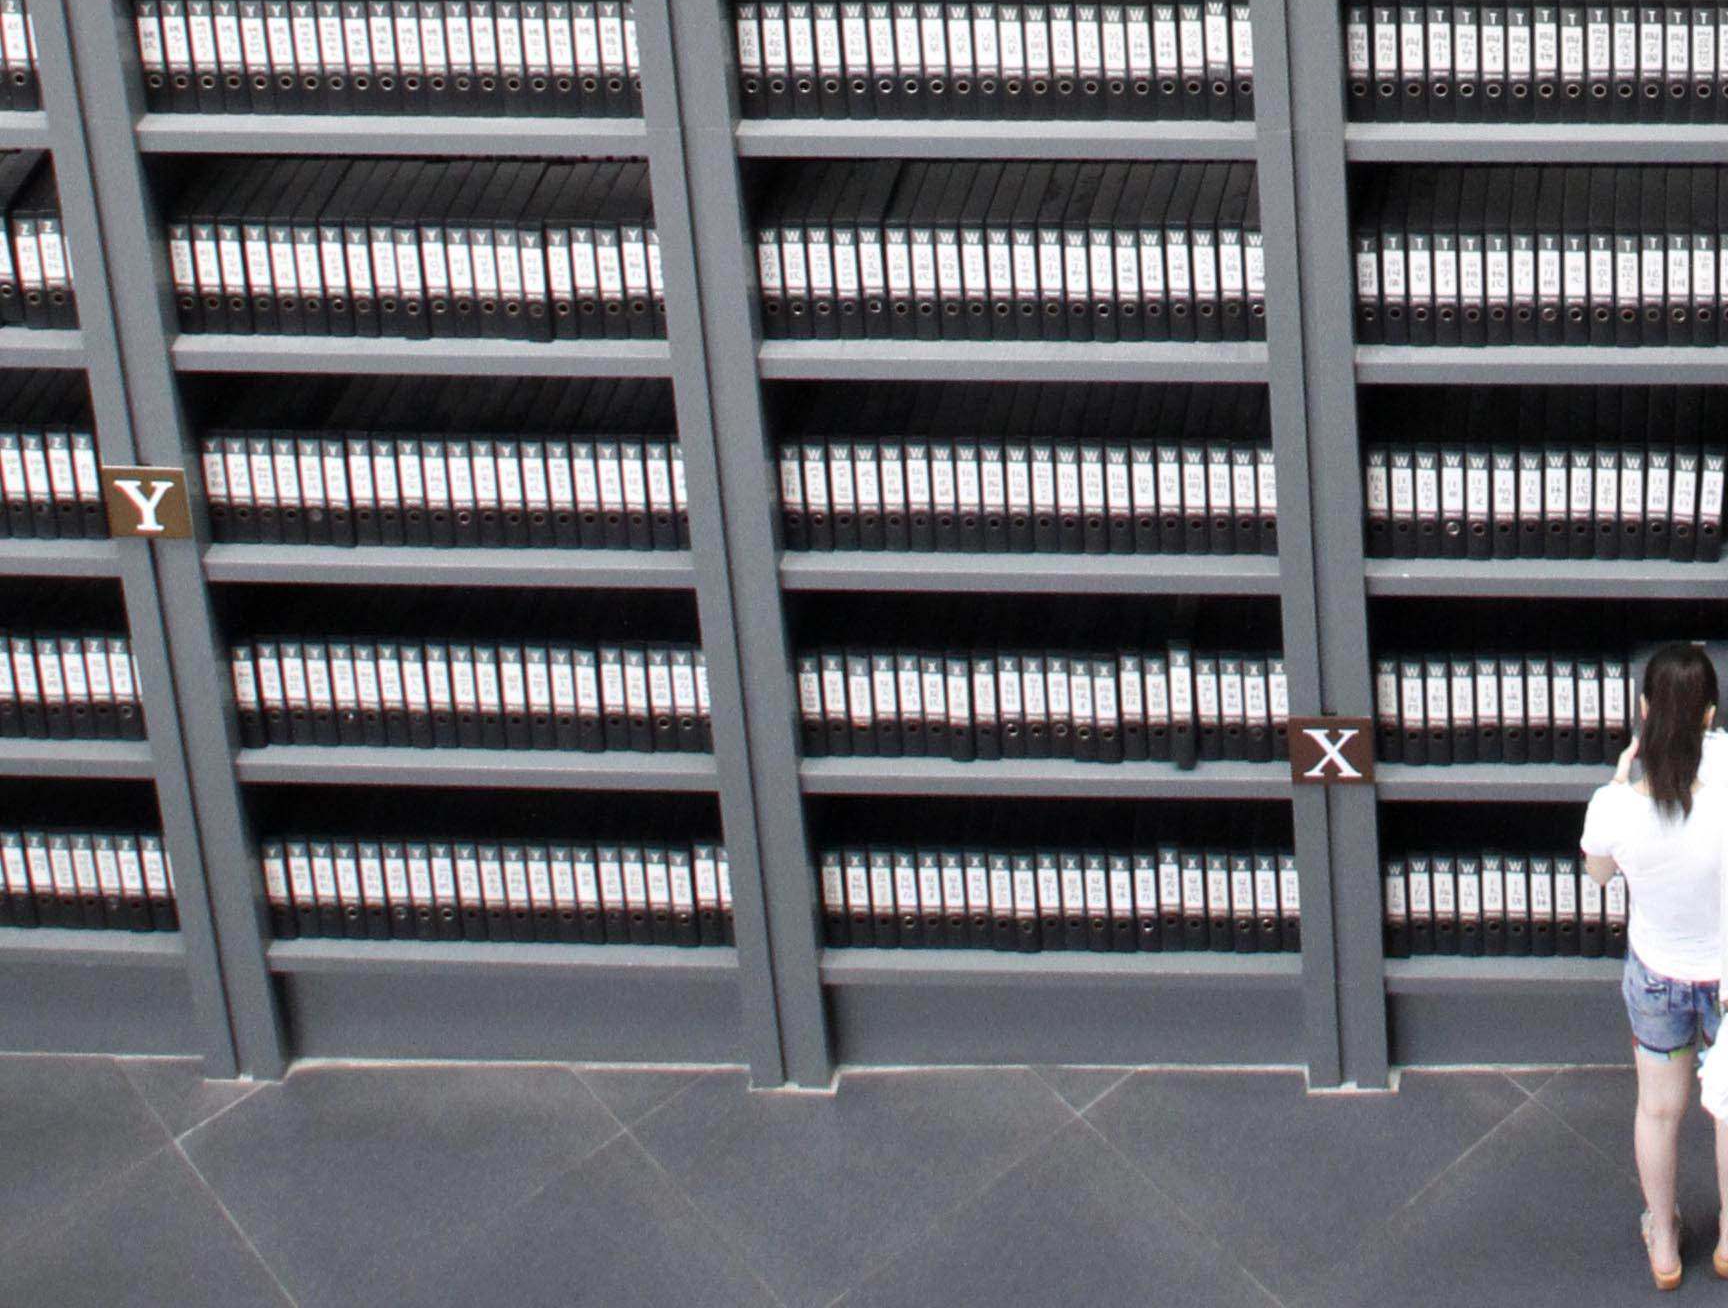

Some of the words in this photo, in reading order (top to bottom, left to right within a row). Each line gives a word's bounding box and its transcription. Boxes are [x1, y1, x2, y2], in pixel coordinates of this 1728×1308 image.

[425, 6, 434, 18] Y
[977, 6, 992, 18] W
[1621, 10, 1629, 22] T
[475, 232, 486, 245] Y
[990, 232, 1006, 244] W
[1624, 240, 1631, 252] T
[857, 449, 872, 461] W
[1600, 457, 1614, 468] W
[114, 480, 174, 531] Y
[1174, 654, 1185, 666] X
[1505, 665, 1519, 676] W
[1303, 729, 1362, 777] X
[921, 856, 934, 867] X
[1412, 861, 1426, 872] W
